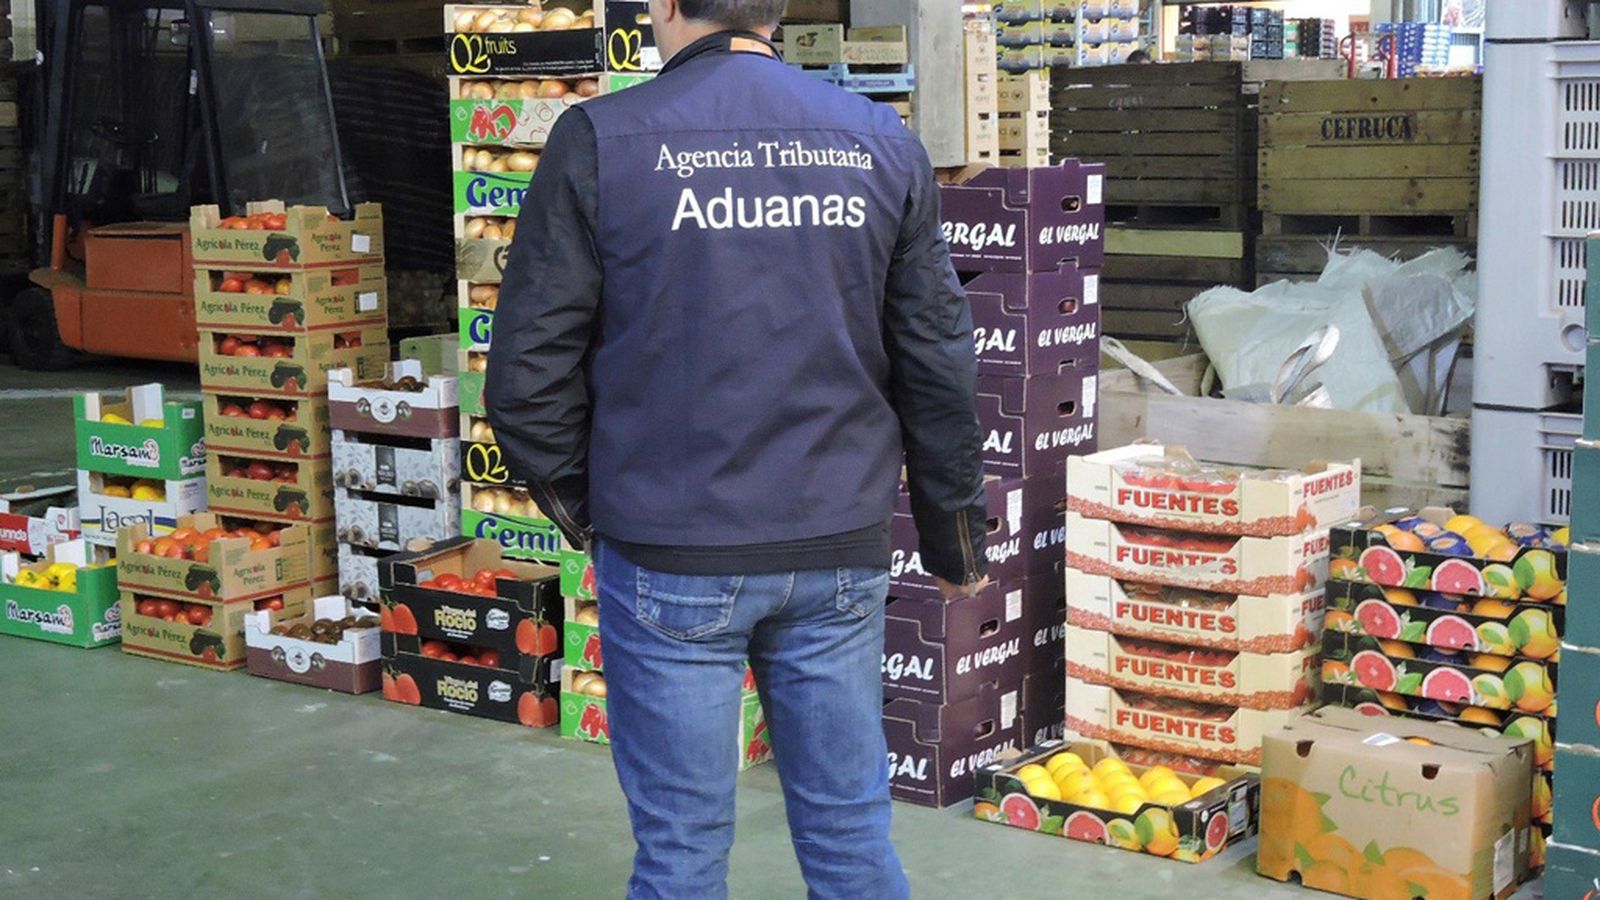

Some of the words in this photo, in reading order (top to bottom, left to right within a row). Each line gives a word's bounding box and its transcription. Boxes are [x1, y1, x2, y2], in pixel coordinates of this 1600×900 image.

[485, 37, 517, 55] fruits
[1321, 116, 1411, 140] CEFRUCA
[654, 143, 755, 177] Agencia
[758, 141, 874, 170] Tributaria
[466, 177, 532, 208] Gem
[671, 187, 866, 231] Aduanas
[942, 221, 1016, 250] ERGAL
[973, 327, 1016, 355] GAL
[1302, 469, 1354, 498] FUENTES
[1117, 488, 1239, 517] FUENTES
[984, 538, 1020, 564] ERGAL
[1302, 536, 1330, 557] FUEN
[1115, 602, 1237, 634] FUENTES
[880, 652, 934, 680] GAL
[1115, 655, 1237, 689] FUENTES
[1115, 709, 1237, 745] FUENTES
[888, 752, 928, 781] GAL
[1338, 764, 1461, 817] Citrus
